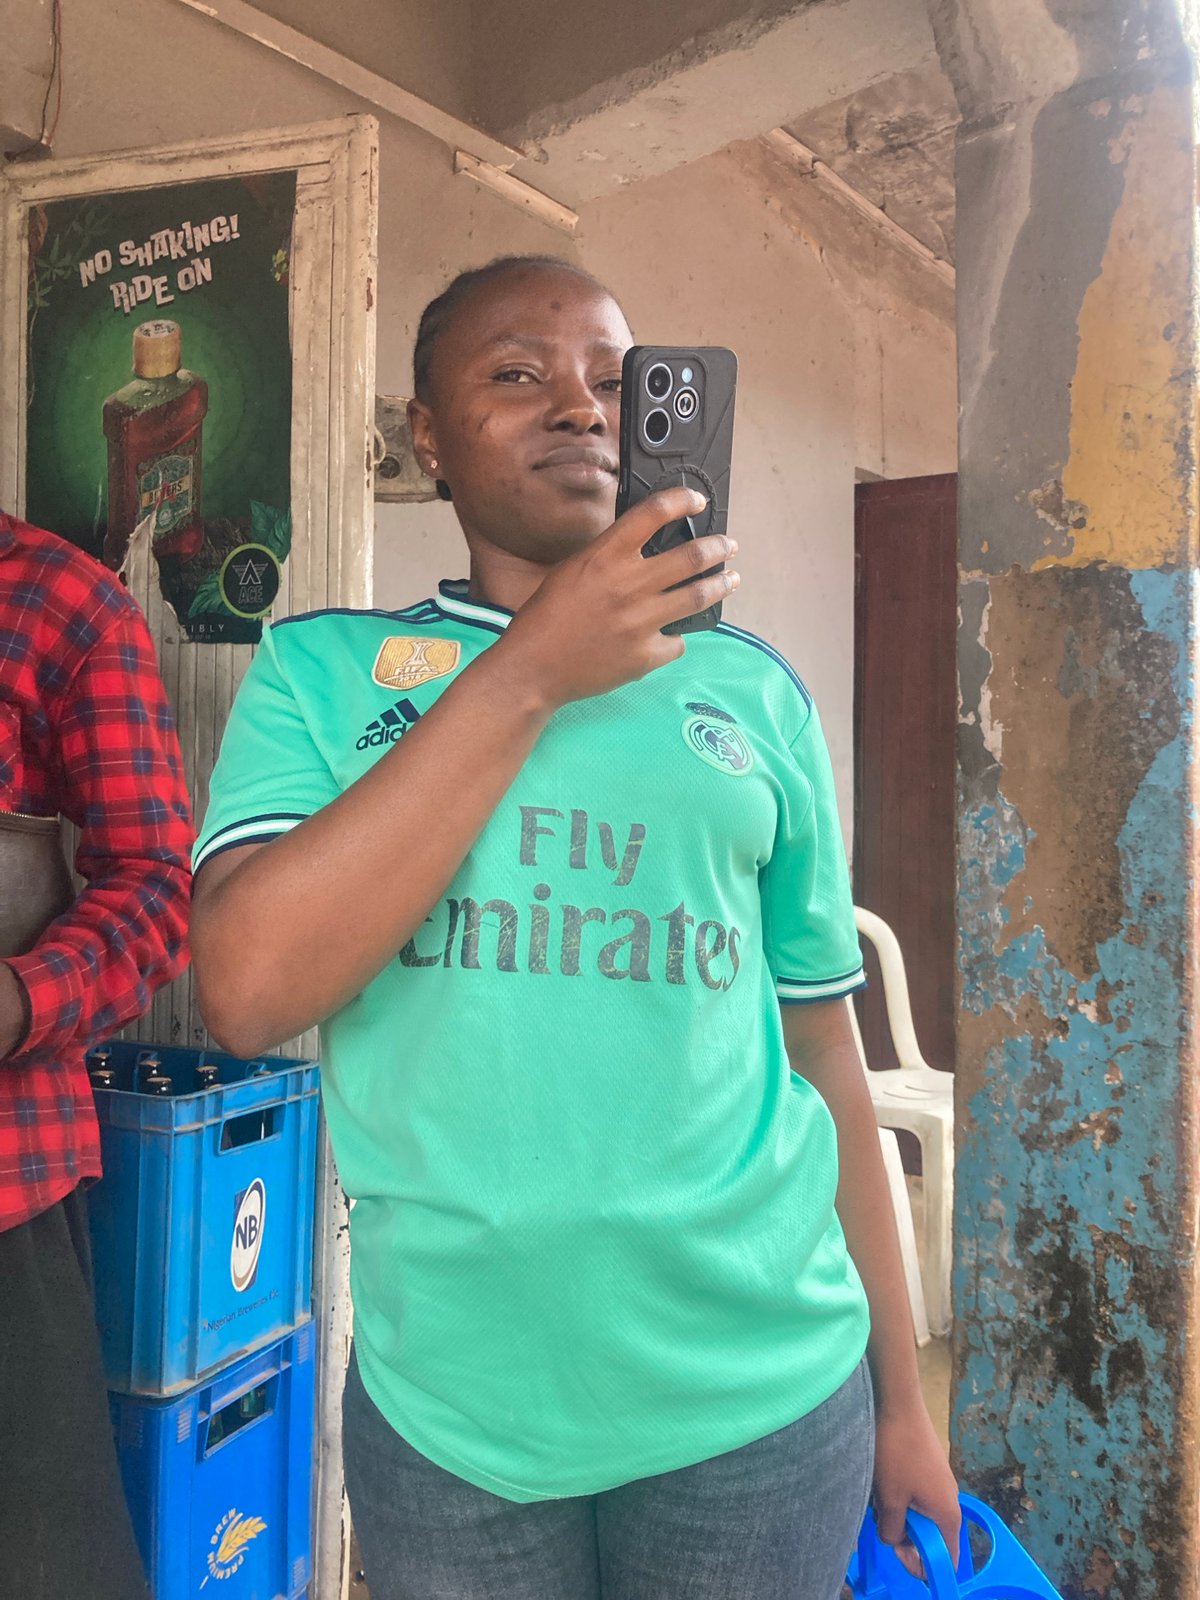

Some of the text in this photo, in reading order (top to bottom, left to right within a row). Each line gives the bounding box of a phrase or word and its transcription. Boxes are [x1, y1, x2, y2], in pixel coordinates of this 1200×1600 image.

[79, 213, 241, 288] NO SHAKING!
[109, 257, 213, 314] RIDE ON
[239, 586, 264, 604] ACE
[394, 665, 432, 676] FIFA
[518, 805, 646, 887] Fly
[235, 1214, 258, 1250] NB
